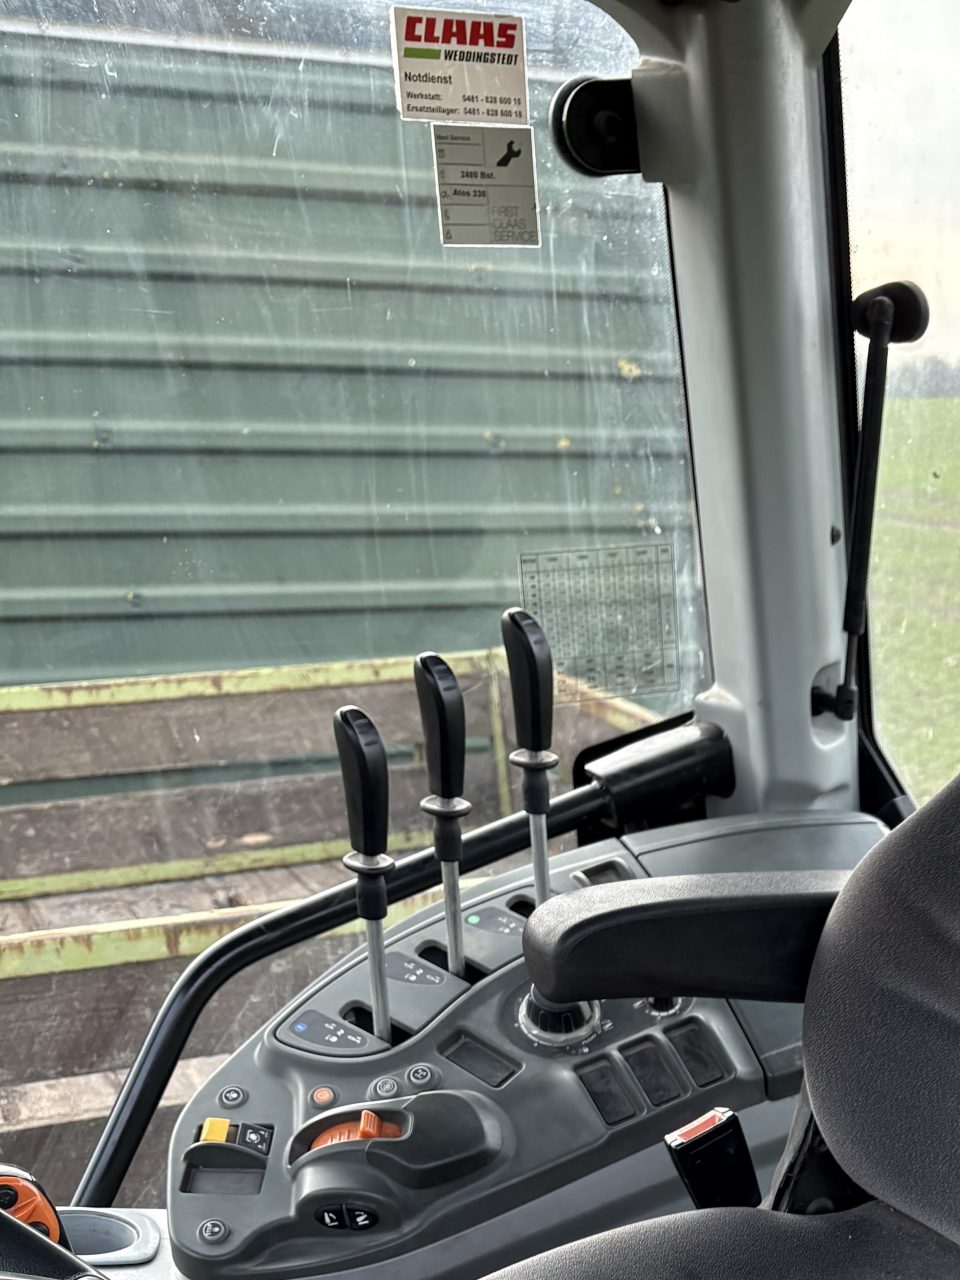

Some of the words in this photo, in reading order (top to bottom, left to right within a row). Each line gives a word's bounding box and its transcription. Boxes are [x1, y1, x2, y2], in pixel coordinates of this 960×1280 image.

[404, 15, 518, 49] CLAAS
[444, 49, 519, 66] WEDDINGSTEDT
[404, 71, 453, 85] Notdienst
[406, 91, 443, 100] Werkstatt:
